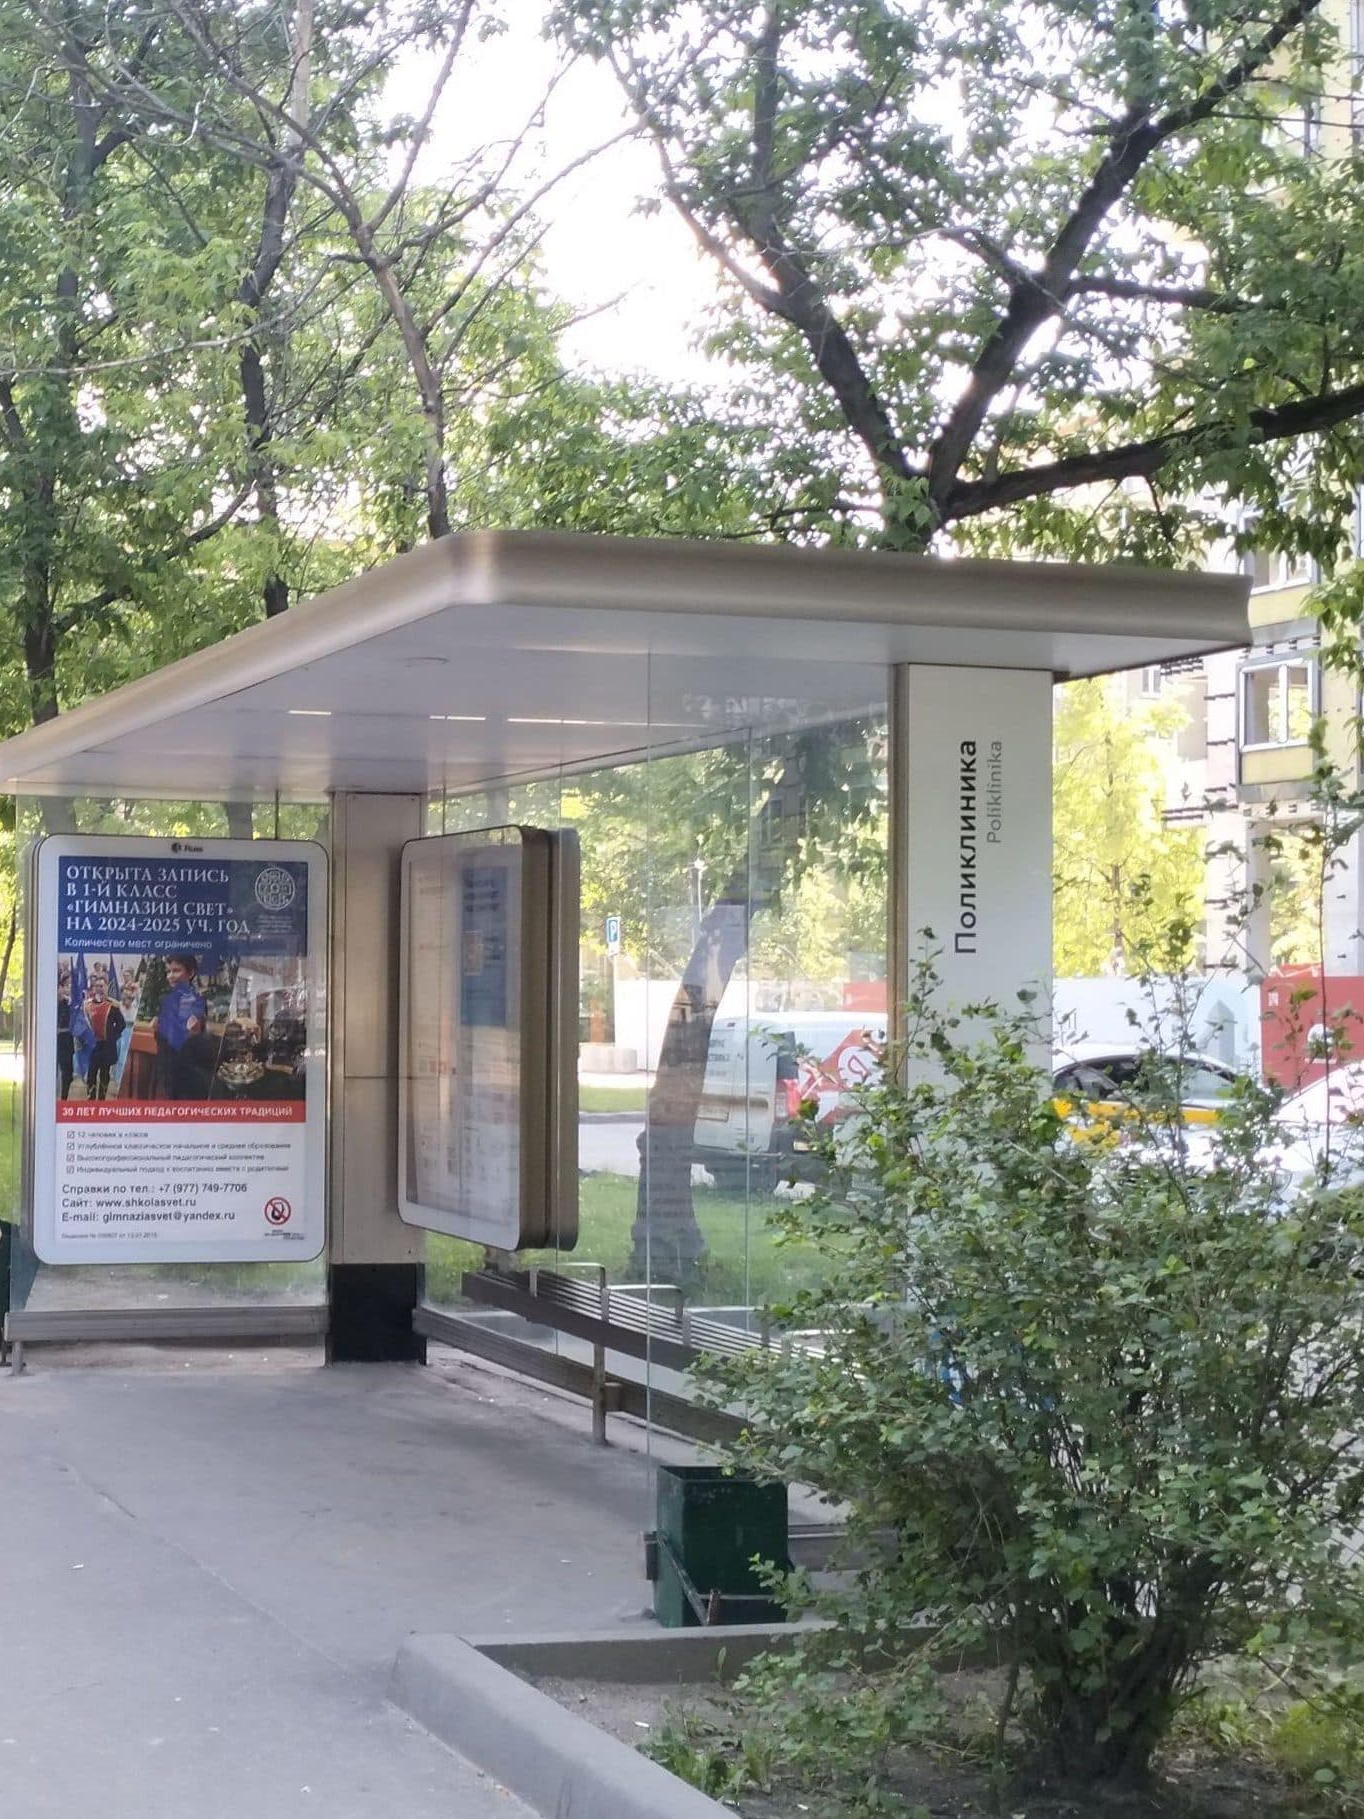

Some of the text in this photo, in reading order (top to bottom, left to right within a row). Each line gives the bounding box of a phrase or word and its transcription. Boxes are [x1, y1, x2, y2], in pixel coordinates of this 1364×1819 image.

[987, 741, 1002, 844] Poliklinika
[955, 740, 977, 954] Поликлиника
[67, 866, 229, 882] ОТКРЫТА ЗАПИСЬ
[67, 880, 177, 898] В 1-Й КЛАСС
[67, 900, 234, 916] «ГИМНАЗИИ СВЕТ»
[66, 916, 92, 930] НА
[98, 917, 180, 932] 2024-2025
[186, 918, 213, 934] УЧ.
[218, 919, 251, 934] ГОД
[64, 937, 213, 950] Количество мест ограничено
[62, 1107, 74, 1117] 30
[76, 1107, 96, 1117] ЛЕТ
[144, 1107, 237, 1117] ПЕДАГОГИЧЕСКИХ
[239, 1105, 293, 1117] ТРАДИЦИЙ
[62, 1184, 110, 1195] Справки
[113, 1185, 126, 1194] по
[159, 1183, 170, 1193] +7
[172, 1183, 199, 1195] (977)
[96, 1198, 197, 1208] www.shkolasvet.ru
[62, 1210, 235, 1223] E-mail: gimnaziasvet@yandex.ru
